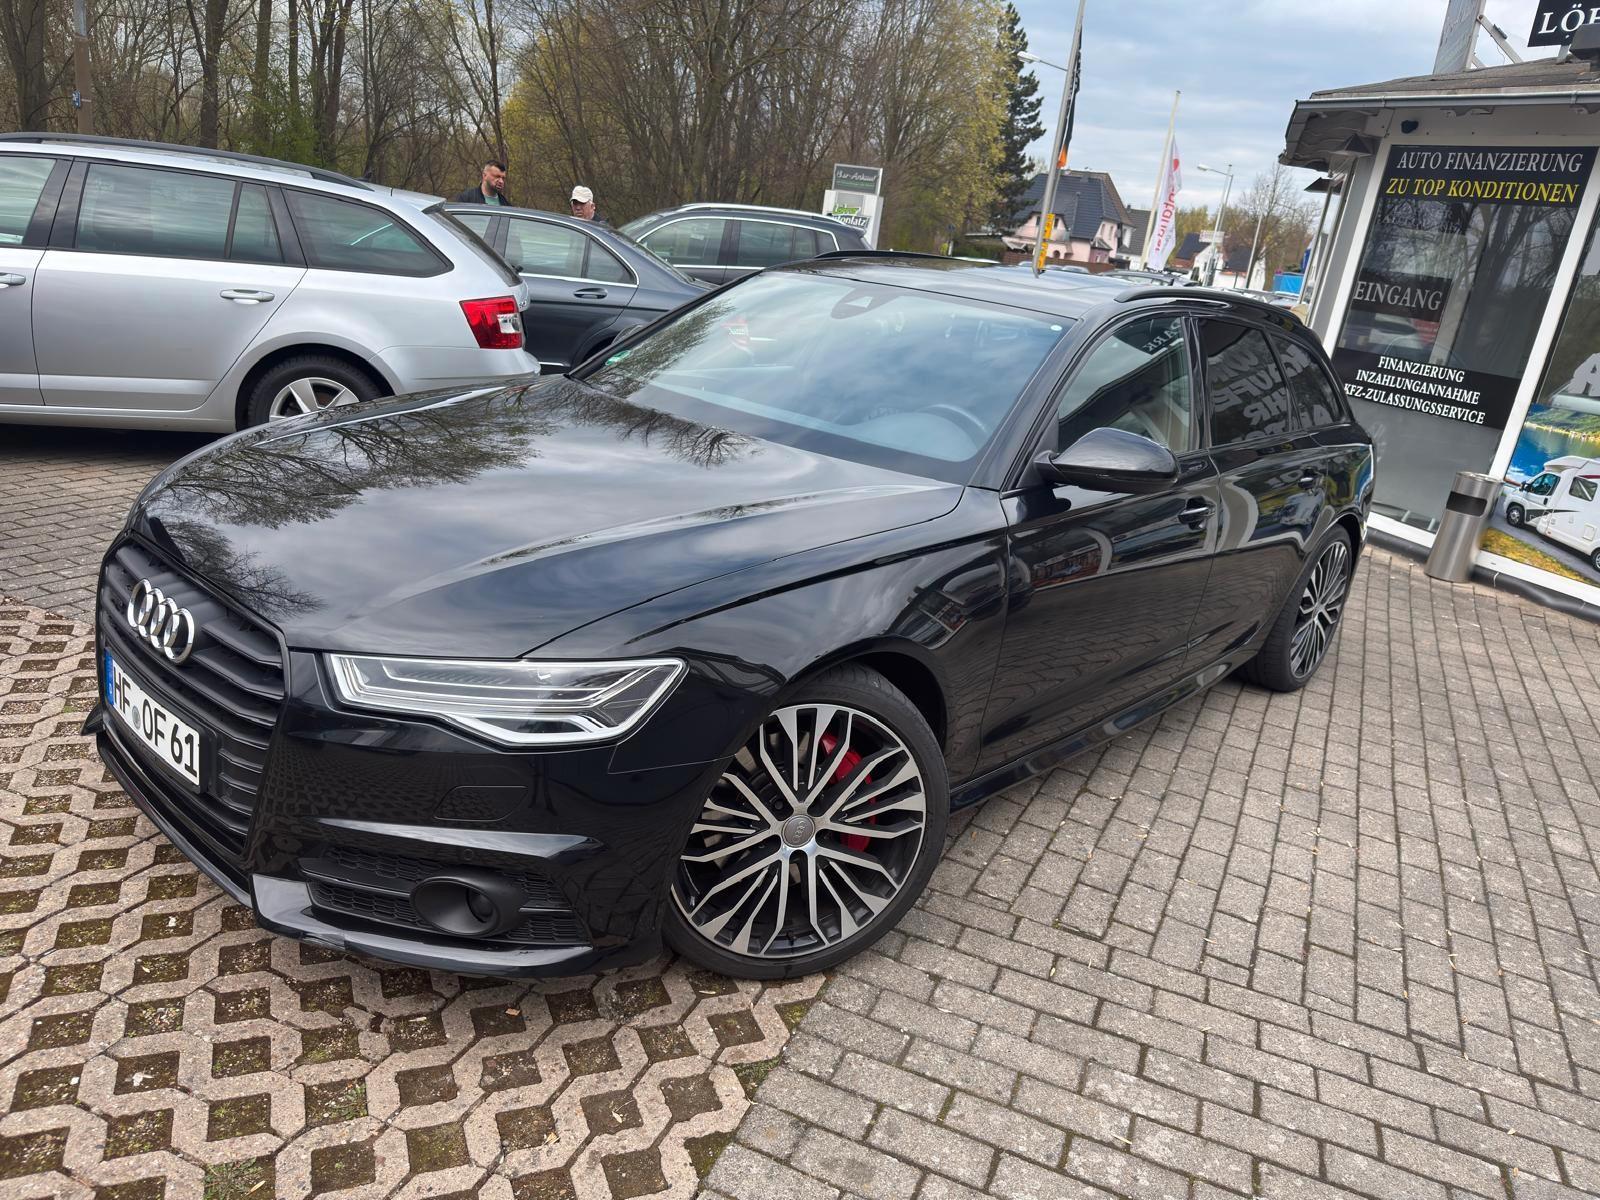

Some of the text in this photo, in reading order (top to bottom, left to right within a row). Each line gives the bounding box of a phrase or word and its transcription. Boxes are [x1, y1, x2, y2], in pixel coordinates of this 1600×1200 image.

[1397, 151, 1583, 173] AUTO FINANZIERUNG
[1386, 178, 1579, 204] ZU TOP KONDITIONEN
[1352, 281, 1443, 311] EINGANG
[1377, 355, 1466, 383] FINANZIERUNG
[1355, 369, 1481, 405] INZAHLUNGANNAHME
[1344, 383, 1486, 425] KFZ-ZULASSUNGSSERVICE
[113, 666, 198, 778] HF OF 61
